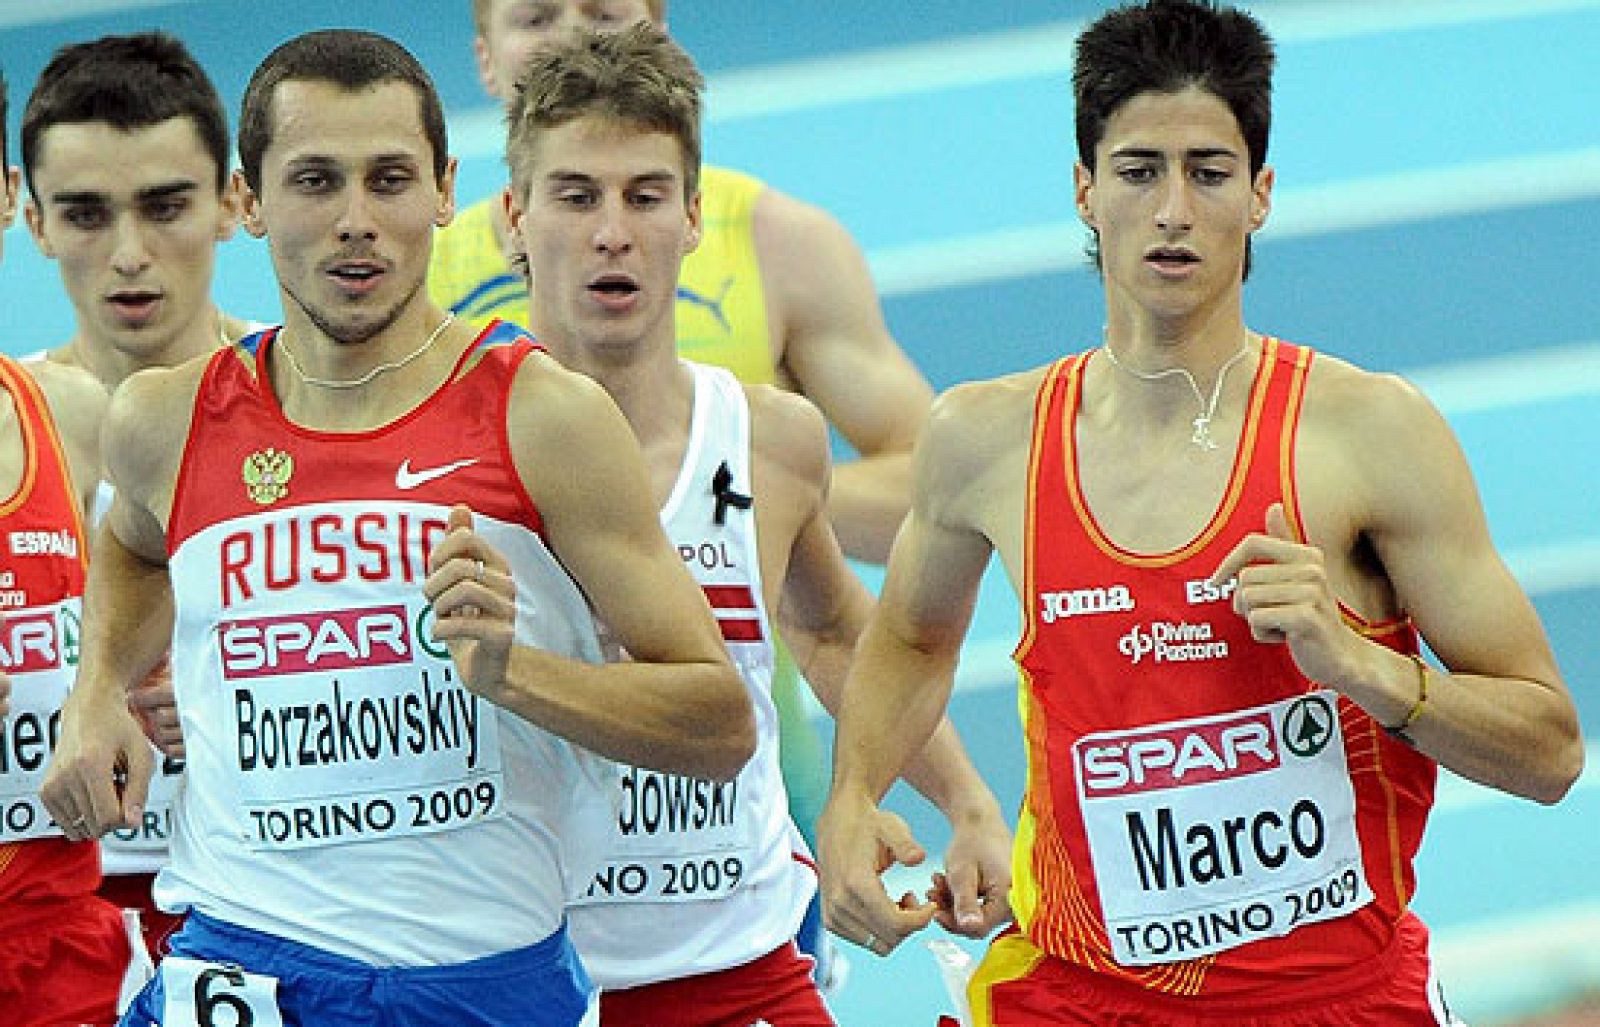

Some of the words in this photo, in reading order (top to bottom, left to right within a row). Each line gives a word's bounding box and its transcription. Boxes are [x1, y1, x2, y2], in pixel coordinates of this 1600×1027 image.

[677, 542, 735, 570] POL
[222, 613, 408, 670] SPAR
[1151, 621, 1212, 641] Divina
[1155, 641, 1228, 663] Pastora
[235, 668, 478, 771] Borzakovskiy
[1085, 722, 1275, 789] SPAR
[249, 800, 396, 842] TORINO
[406, 781, 496, 827] 2009
[1125, 799, 1325, 891] Marco
[660, 857, 743, 895] 2009
[1117, 903, 1274, 957] TORINO
[1285, 869, 1360, 926] 2009
